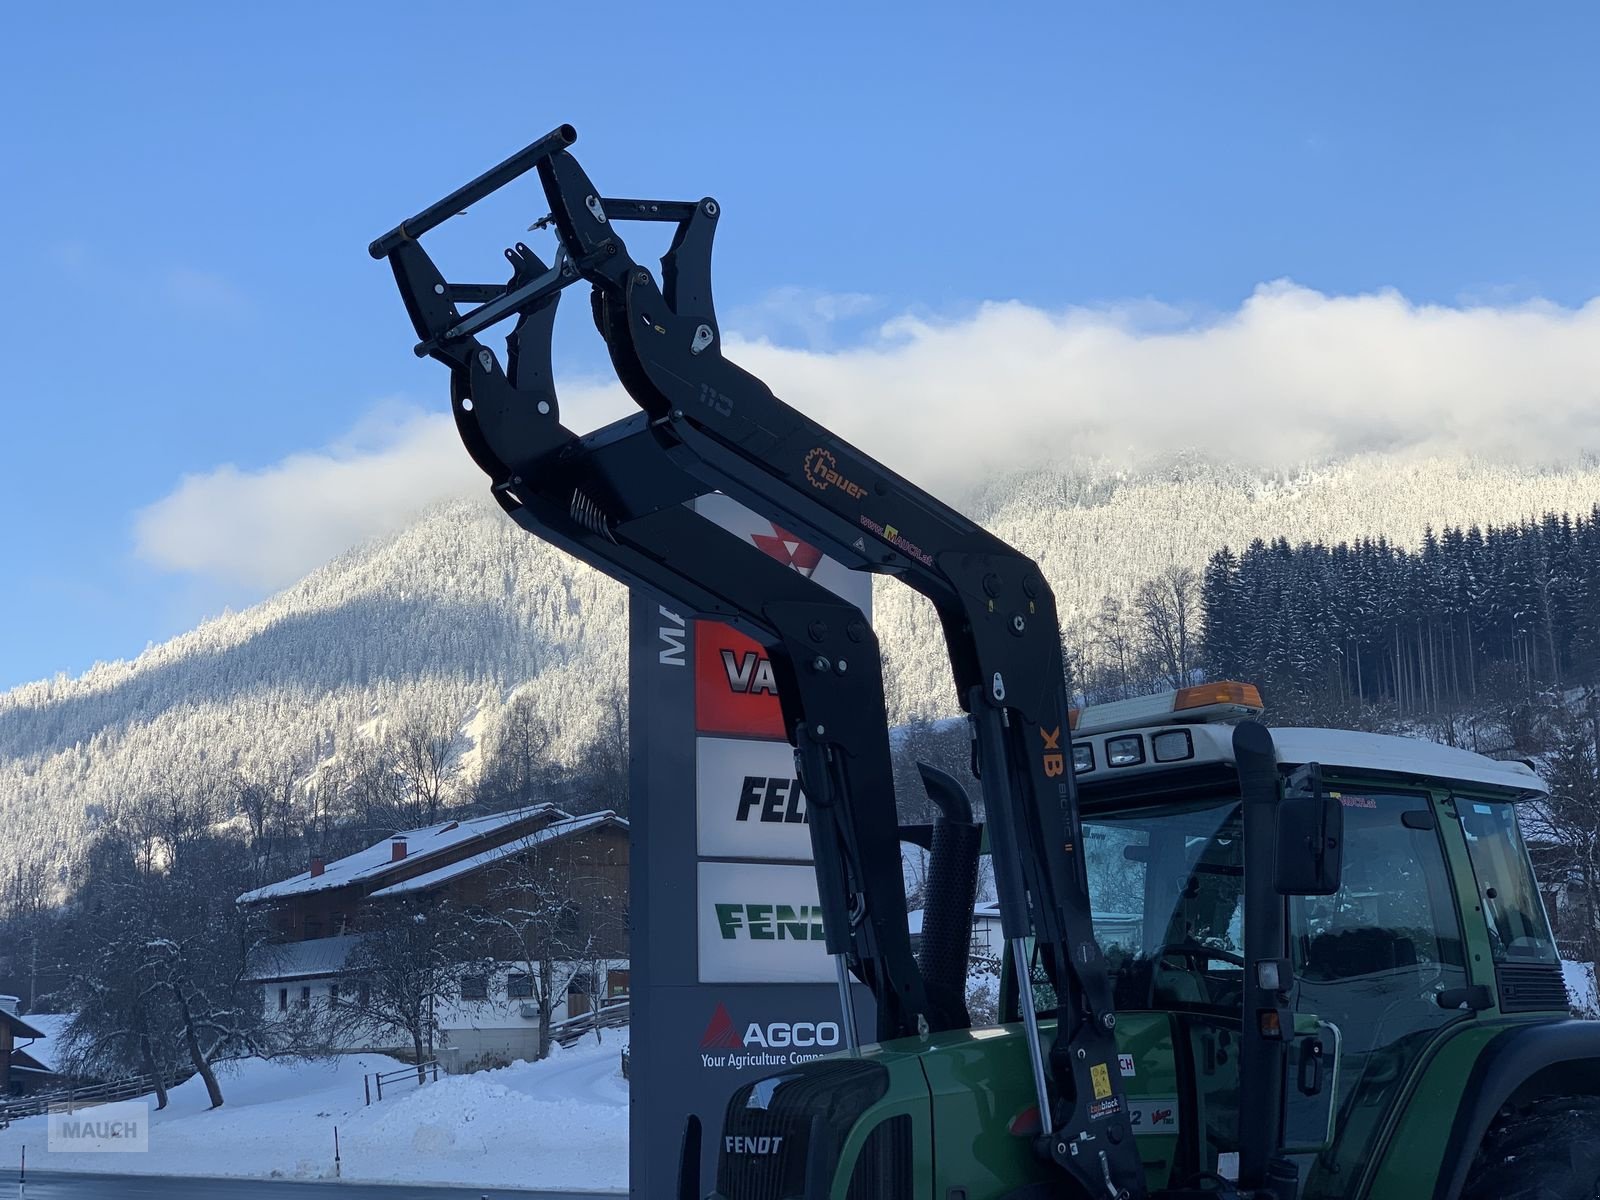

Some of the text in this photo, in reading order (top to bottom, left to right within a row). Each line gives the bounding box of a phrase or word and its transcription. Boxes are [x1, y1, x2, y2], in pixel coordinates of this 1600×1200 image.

[814, 457, 868, 500] hauer
[736, 776, 809, 824] FEL
[743, 1022, 839, 1048] AGCO
[701, 1053, 726, 1068] Your
[728, 1052, 787, 1070] Agriculture
[725, 1136, 783, 1154] FENDT
